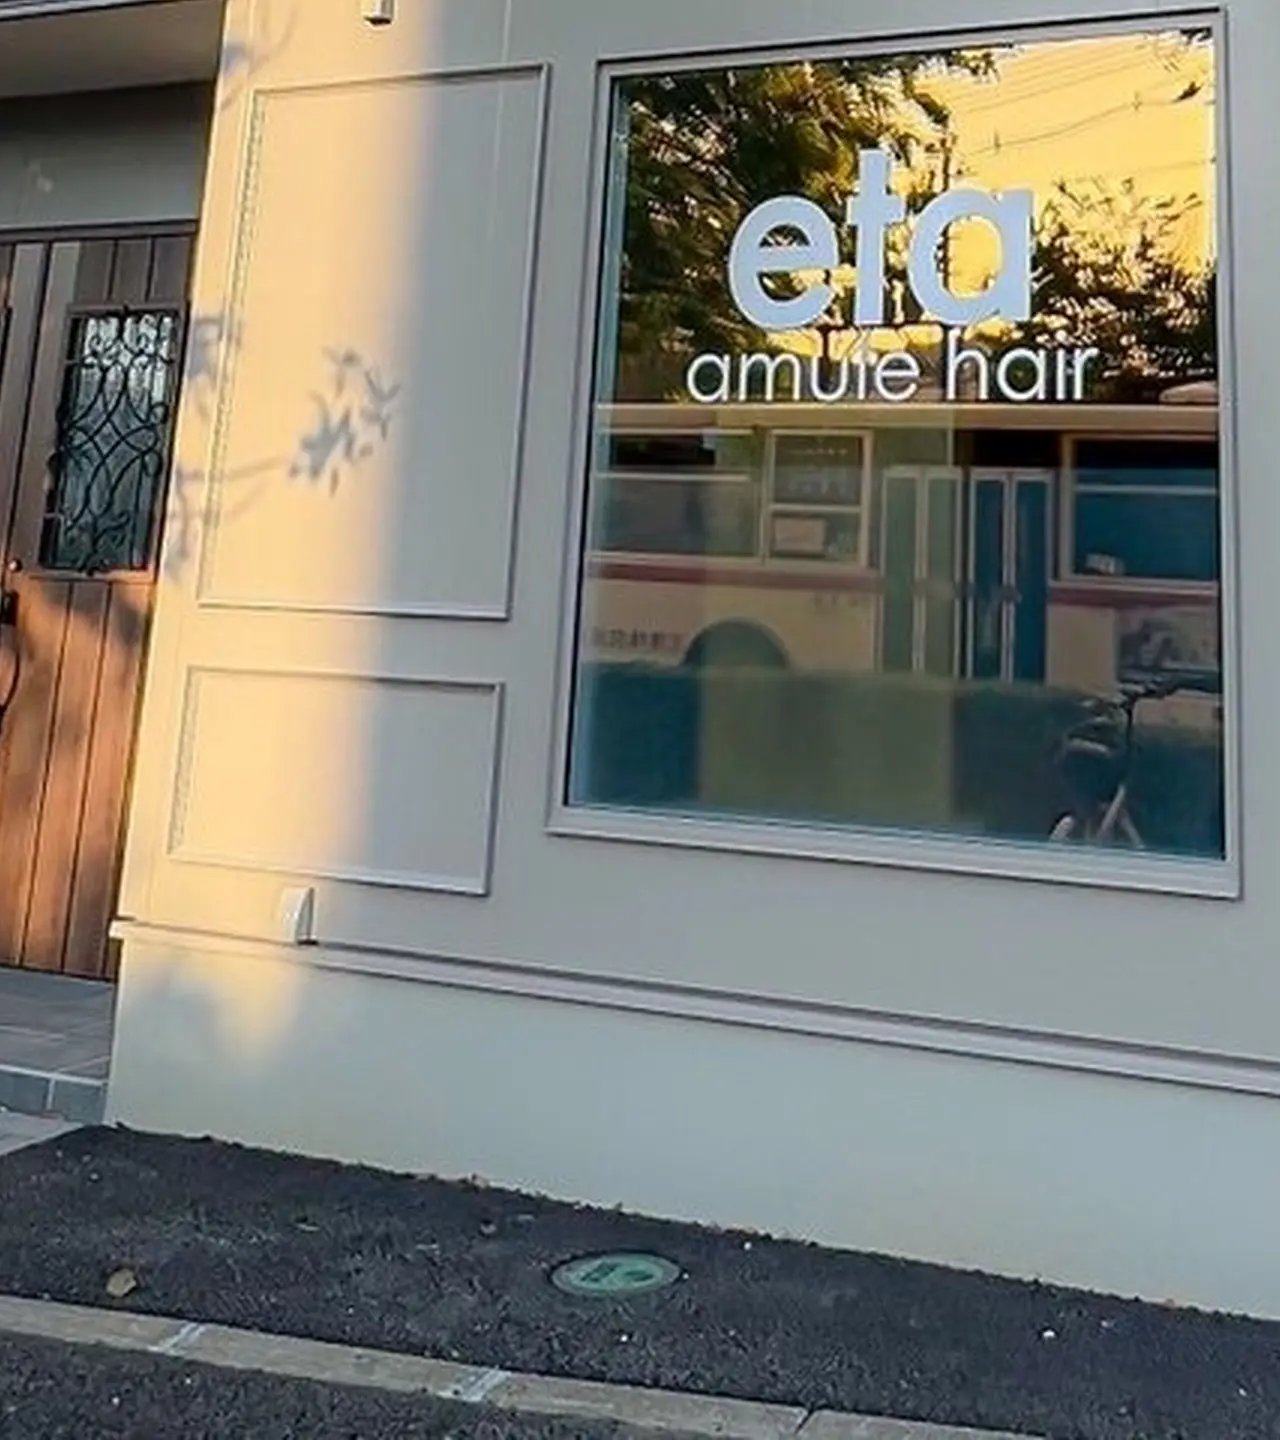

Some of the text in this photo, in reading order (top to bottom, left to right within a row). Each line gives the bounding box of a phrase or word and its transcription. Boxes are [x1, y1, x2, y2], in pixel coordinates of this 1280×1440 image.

[728, 148, 1034, 329] eta
[687, 328, 1100, 402] amule hair
